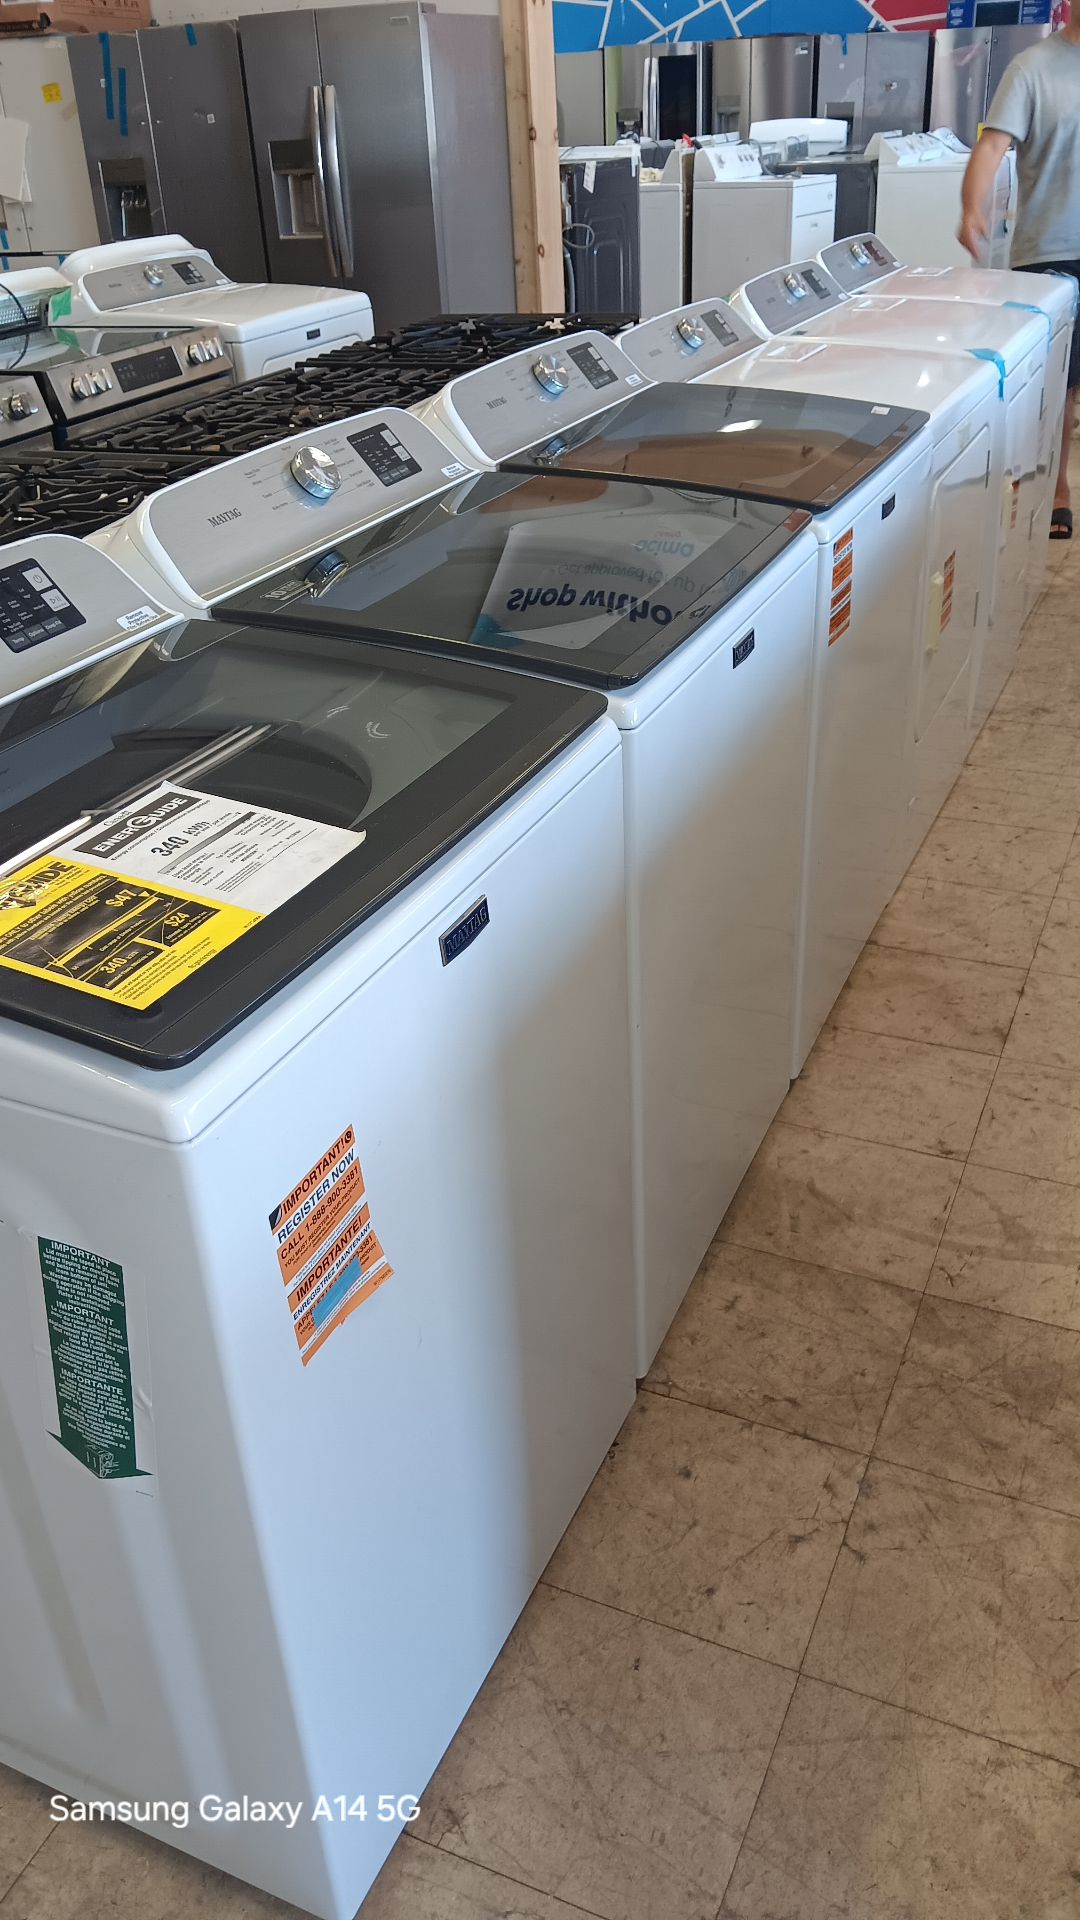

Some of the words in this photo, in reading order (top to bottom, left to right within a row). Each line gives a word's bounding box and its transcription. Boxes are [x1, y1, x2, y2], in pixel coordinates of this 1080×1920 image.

[207, 507, 243, 527] MAYTAG
[125, 610, 144, 620] Remove
[151, 836, 188, 856] 340
[182, 821, 209, 834] kWh
[105, 889, 136, 906] $47
[164, 912, 189, 926] $24
[446, 906, 487, 956] MAYTAG
[100, 957, 127, 973] 340
[283, 1139, 344, 1213] IMPORTANT!
[278, 1179, 329, 1243] REGISTER
[331, 1148, 353, 1182] NOW
[281, 1232, 304, 1259] CALL
[305, 1166, 358, 1232] 1-888-900-3381
[284, 1254, 296, 1268] YOU
[295, 1239, 307, 1256] MUST
[308, 1214, 329, 1241] REGISTER
[329, 1200, 341, 1215] YOUR
[341, 1177, 360, 1202] PRODUCT
[51, 1241, 111, 1268] IMPORTANT
[296, 1216, 363, 1301] IMPORTANTE!
[293, 1267, 335, 1320] ENREGISTREZ
[335, 1221, 371, 1269] MAINTENANT
[56, 1300, 114, 1326] IMPORTANT
[61, 1367, 124, 1395] IMPORTANTE
